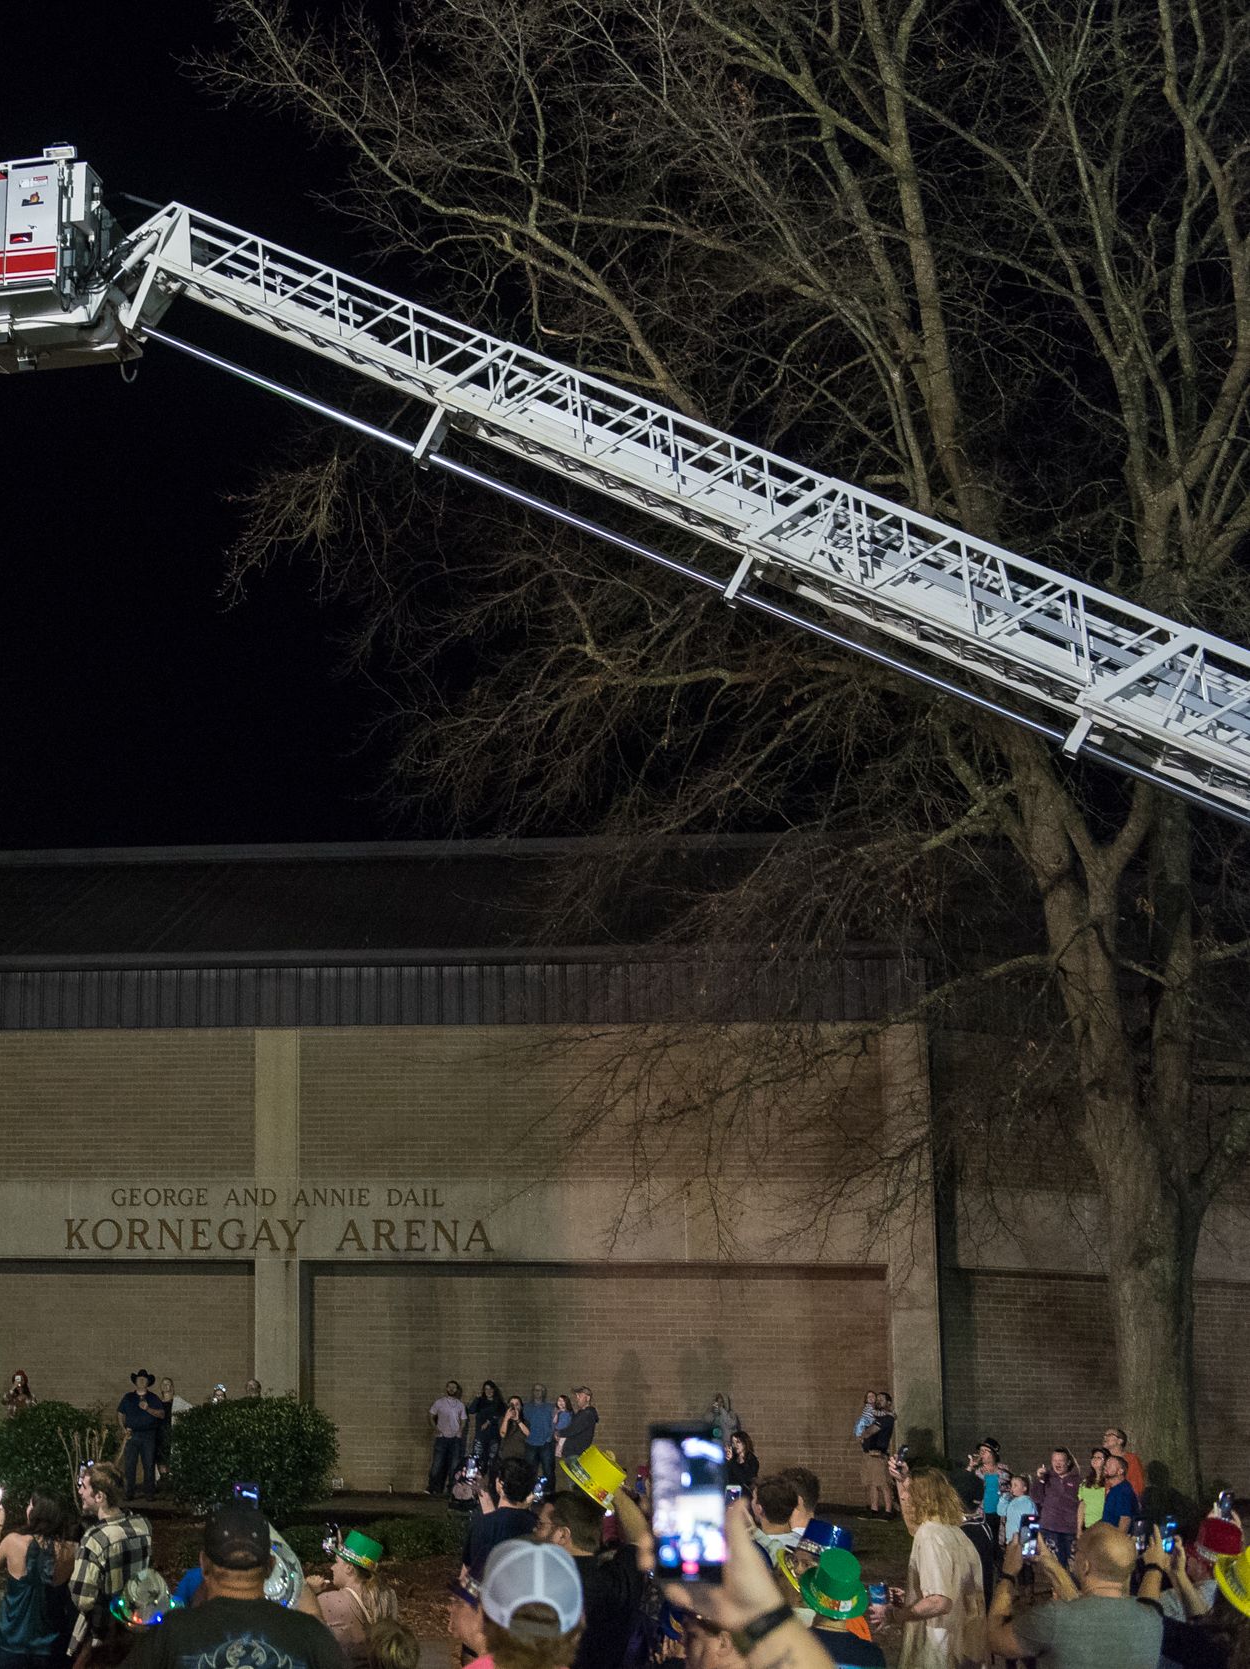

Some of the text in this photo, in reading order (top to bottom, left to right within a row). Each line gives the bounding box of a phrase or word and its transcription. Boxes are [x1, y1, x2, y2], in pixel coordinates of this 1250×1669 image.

[111, 1188, 445, 1207] GEORGE AND ANNIE DAIL
[64, 1218, 495, 1252] KORNEGAY ARENA
